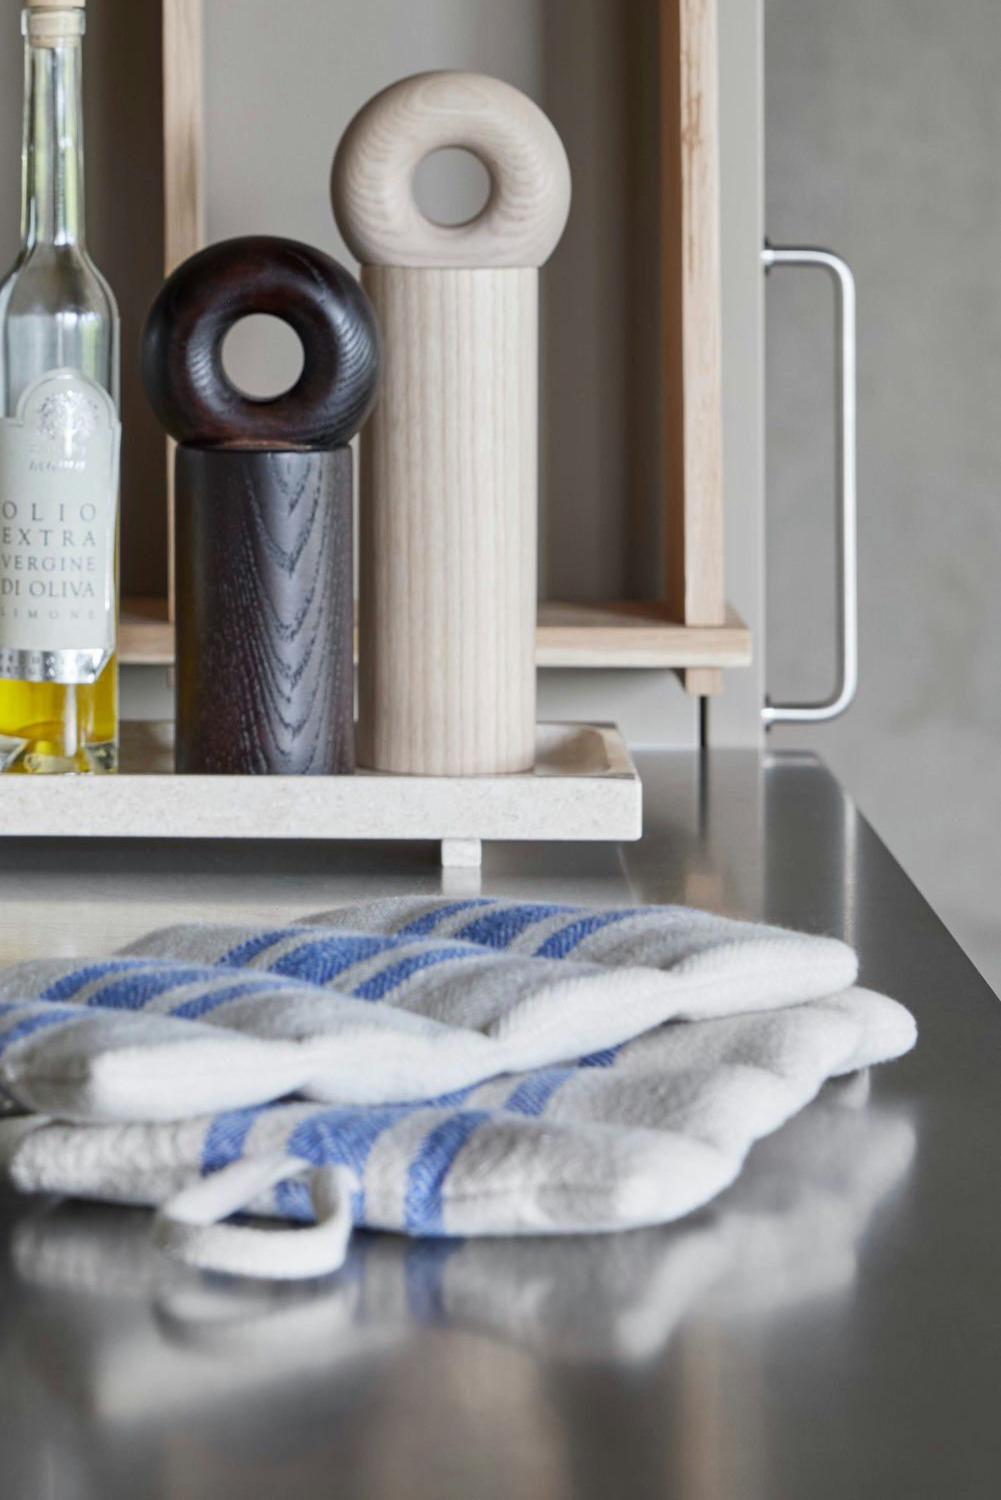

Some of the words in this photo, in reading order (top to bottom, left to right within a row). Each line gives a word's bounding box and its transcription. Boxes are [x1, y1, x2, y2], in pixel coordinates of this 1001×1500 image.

[1, 501, 97, 523] OLIO
[1, 526, 97, 548] EXTRA
[1, 554, 96, 573] VERGINE
[1, 577, 20, 597] DI
[28, 579, 95, 598] OLIVA
